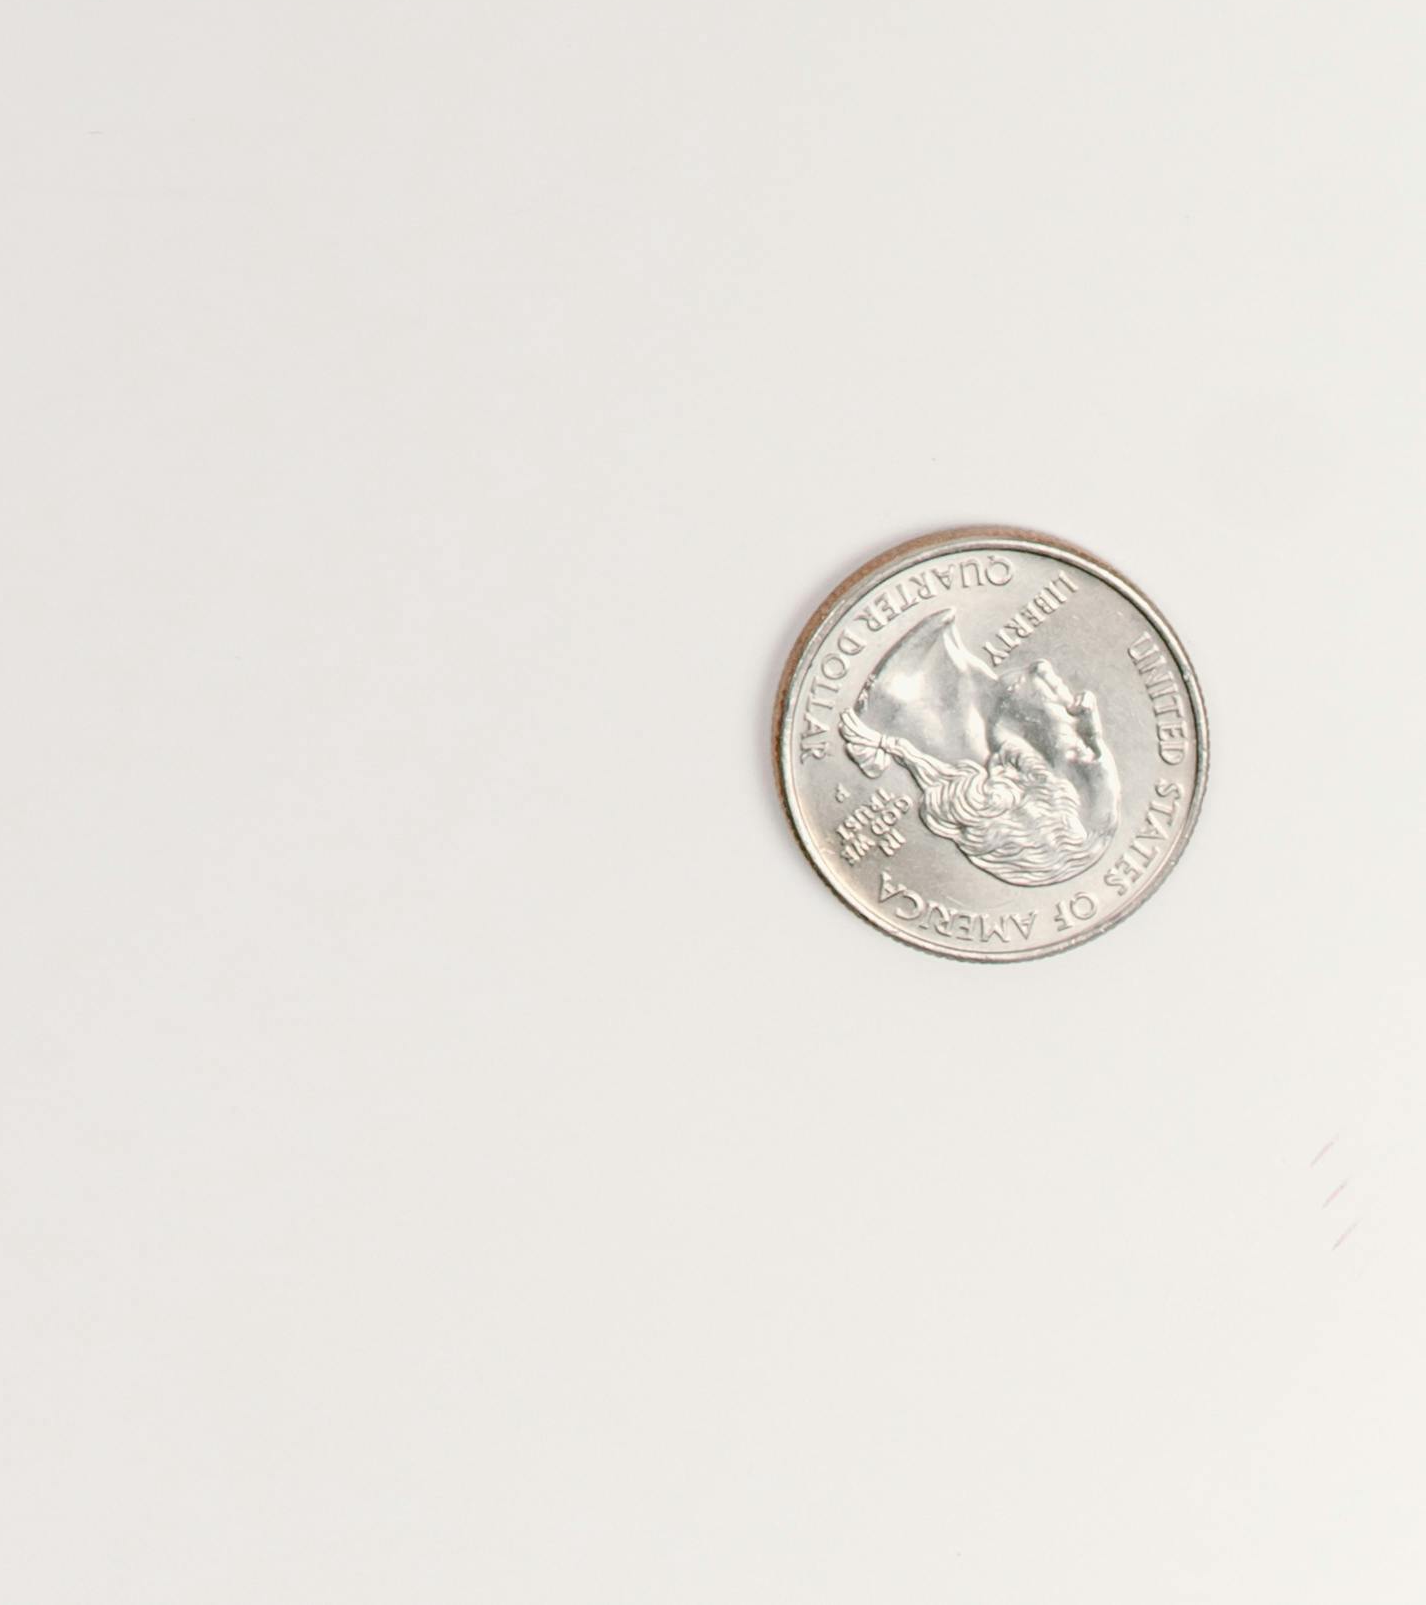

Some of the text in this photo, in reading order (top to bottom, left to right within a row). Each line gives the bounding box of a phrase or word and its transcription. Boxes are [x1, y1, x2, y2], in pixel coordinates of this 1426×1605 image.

[798, 556, 1015, 766] QUARTER DOLLAR
[980, 571, 1081, 668] LIBERTY
[876, 632, 1189, 944] UNITED STATES OF AMERICA
